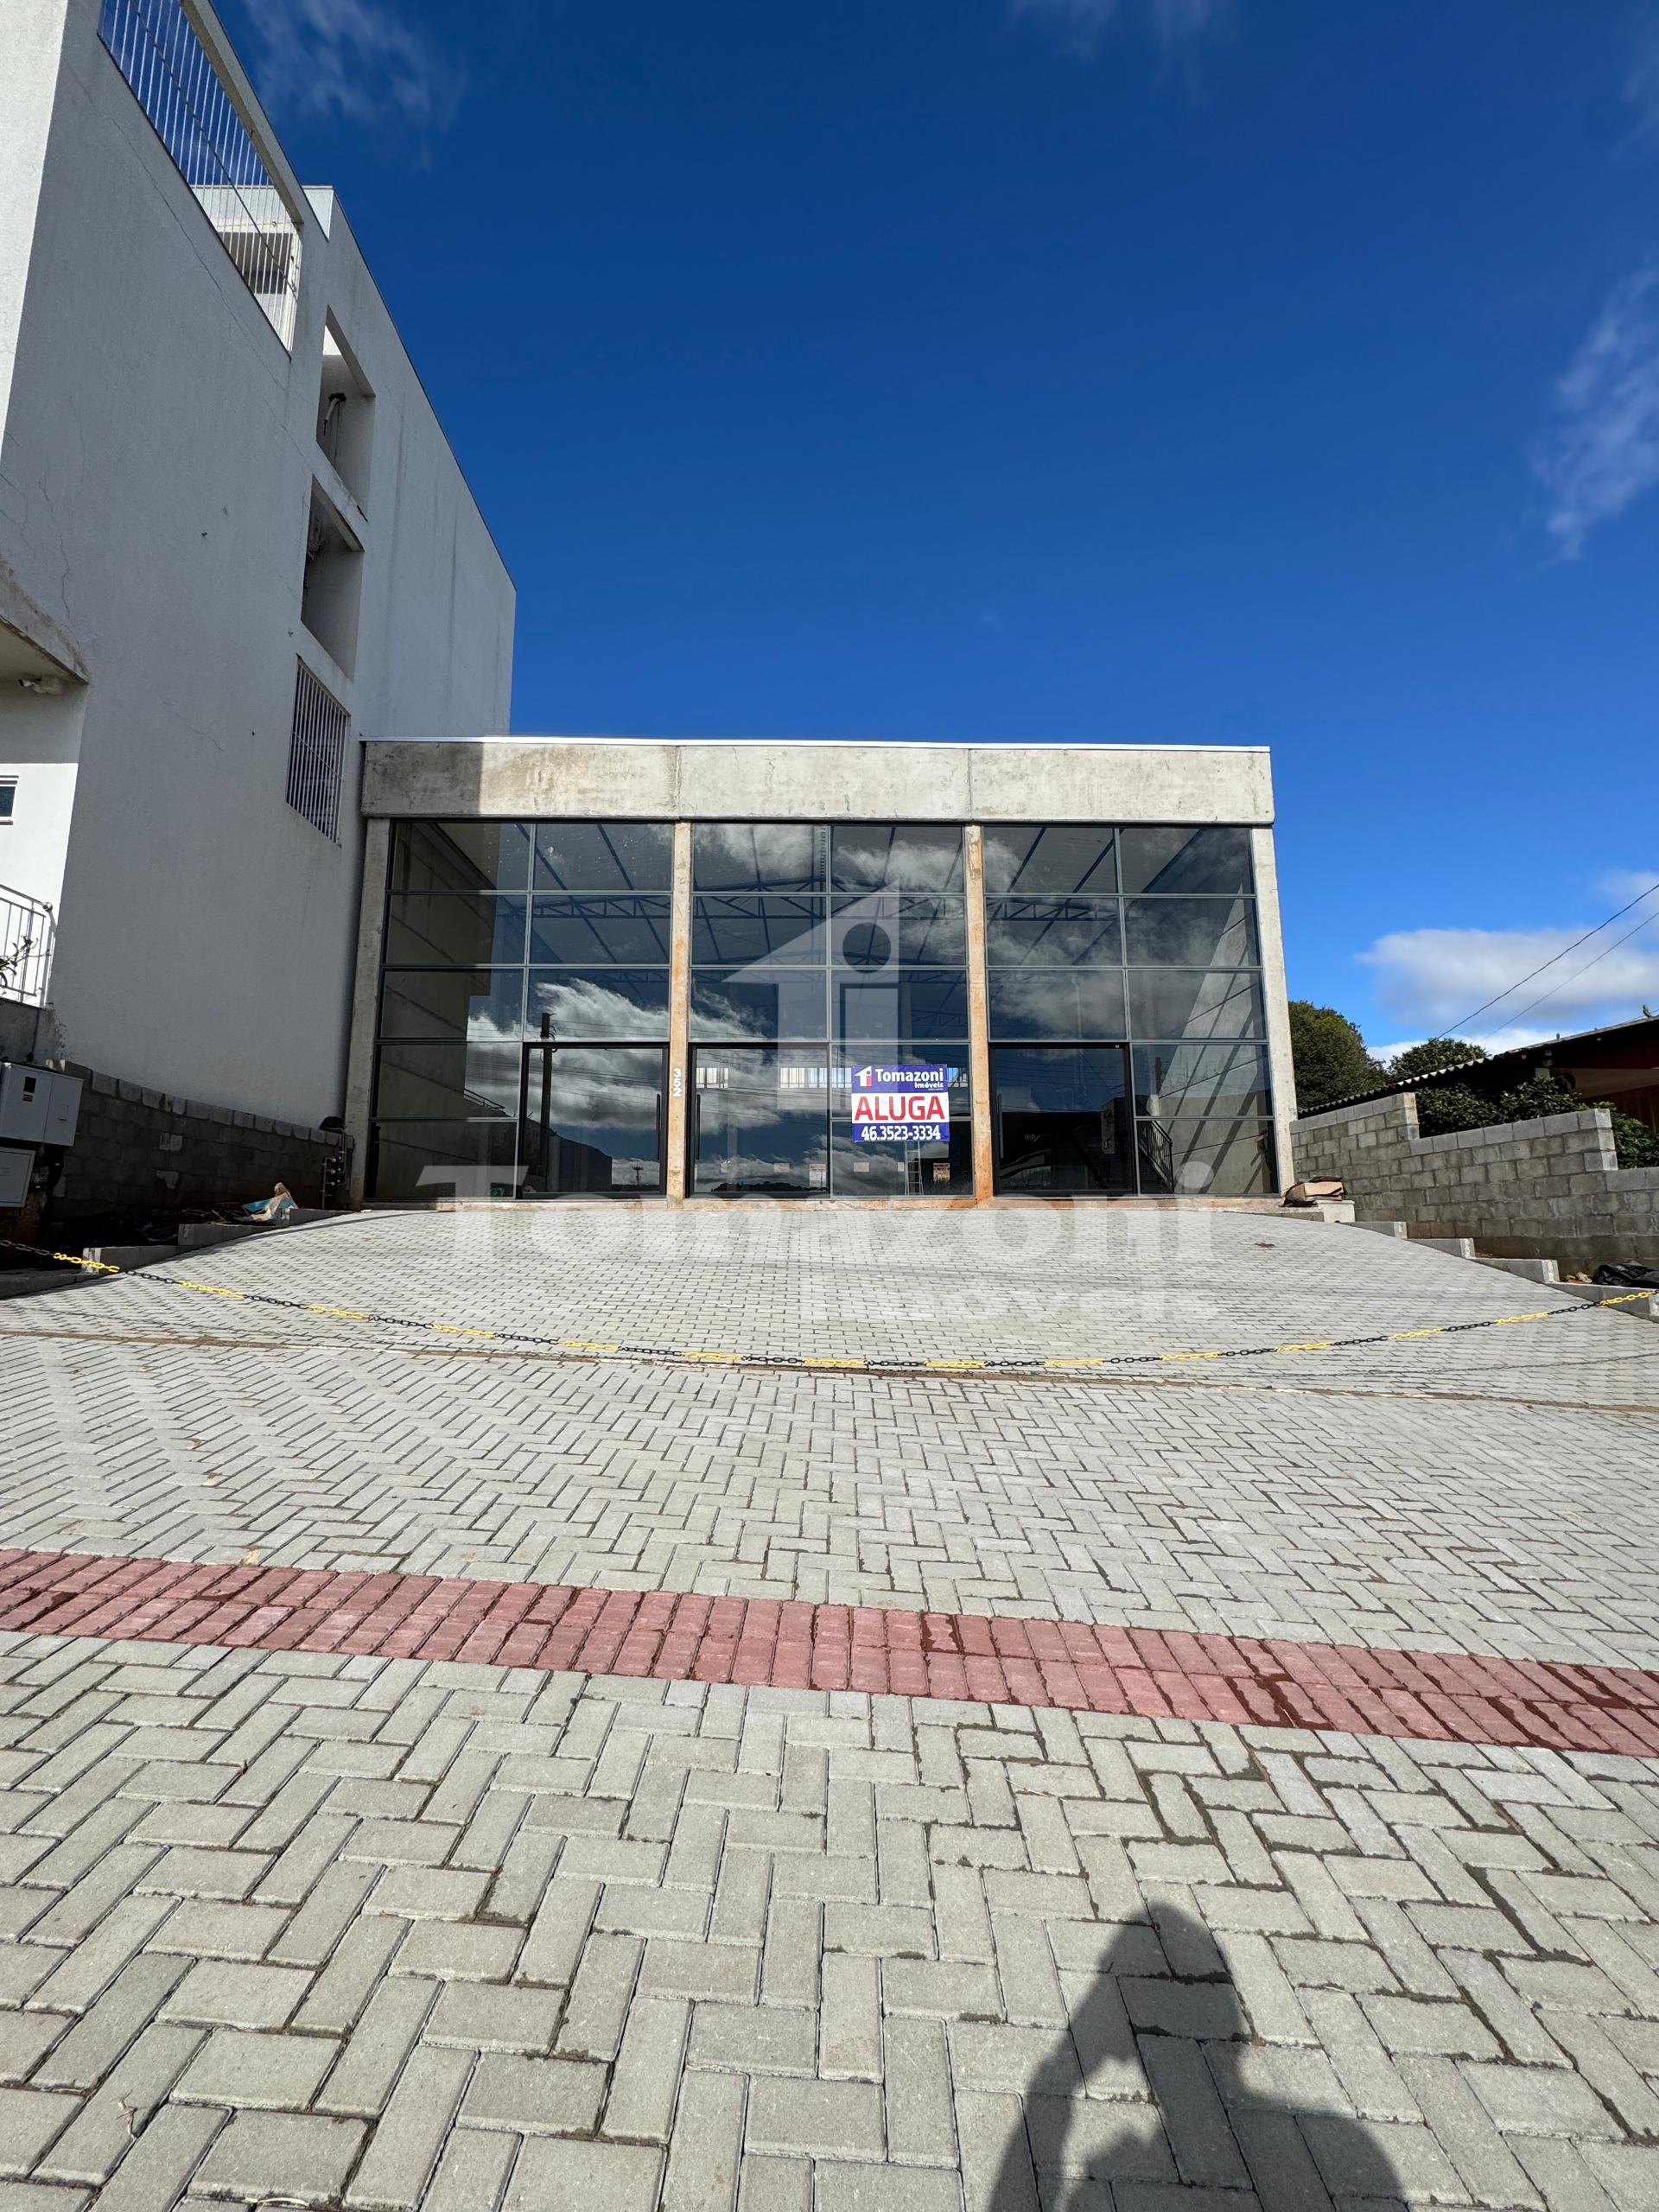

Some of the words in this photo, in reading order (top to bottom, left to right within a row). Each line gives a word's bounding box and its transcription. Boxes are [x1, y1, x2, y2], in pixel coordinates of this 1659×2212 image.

[673, 1068, 682, 1097] 352
[875, 1068, 944, 1082] Tomazoni
[855, 1096, 945, 1121] ALUGA
[861, 1125, 941, 1141] 46.3523-3334
